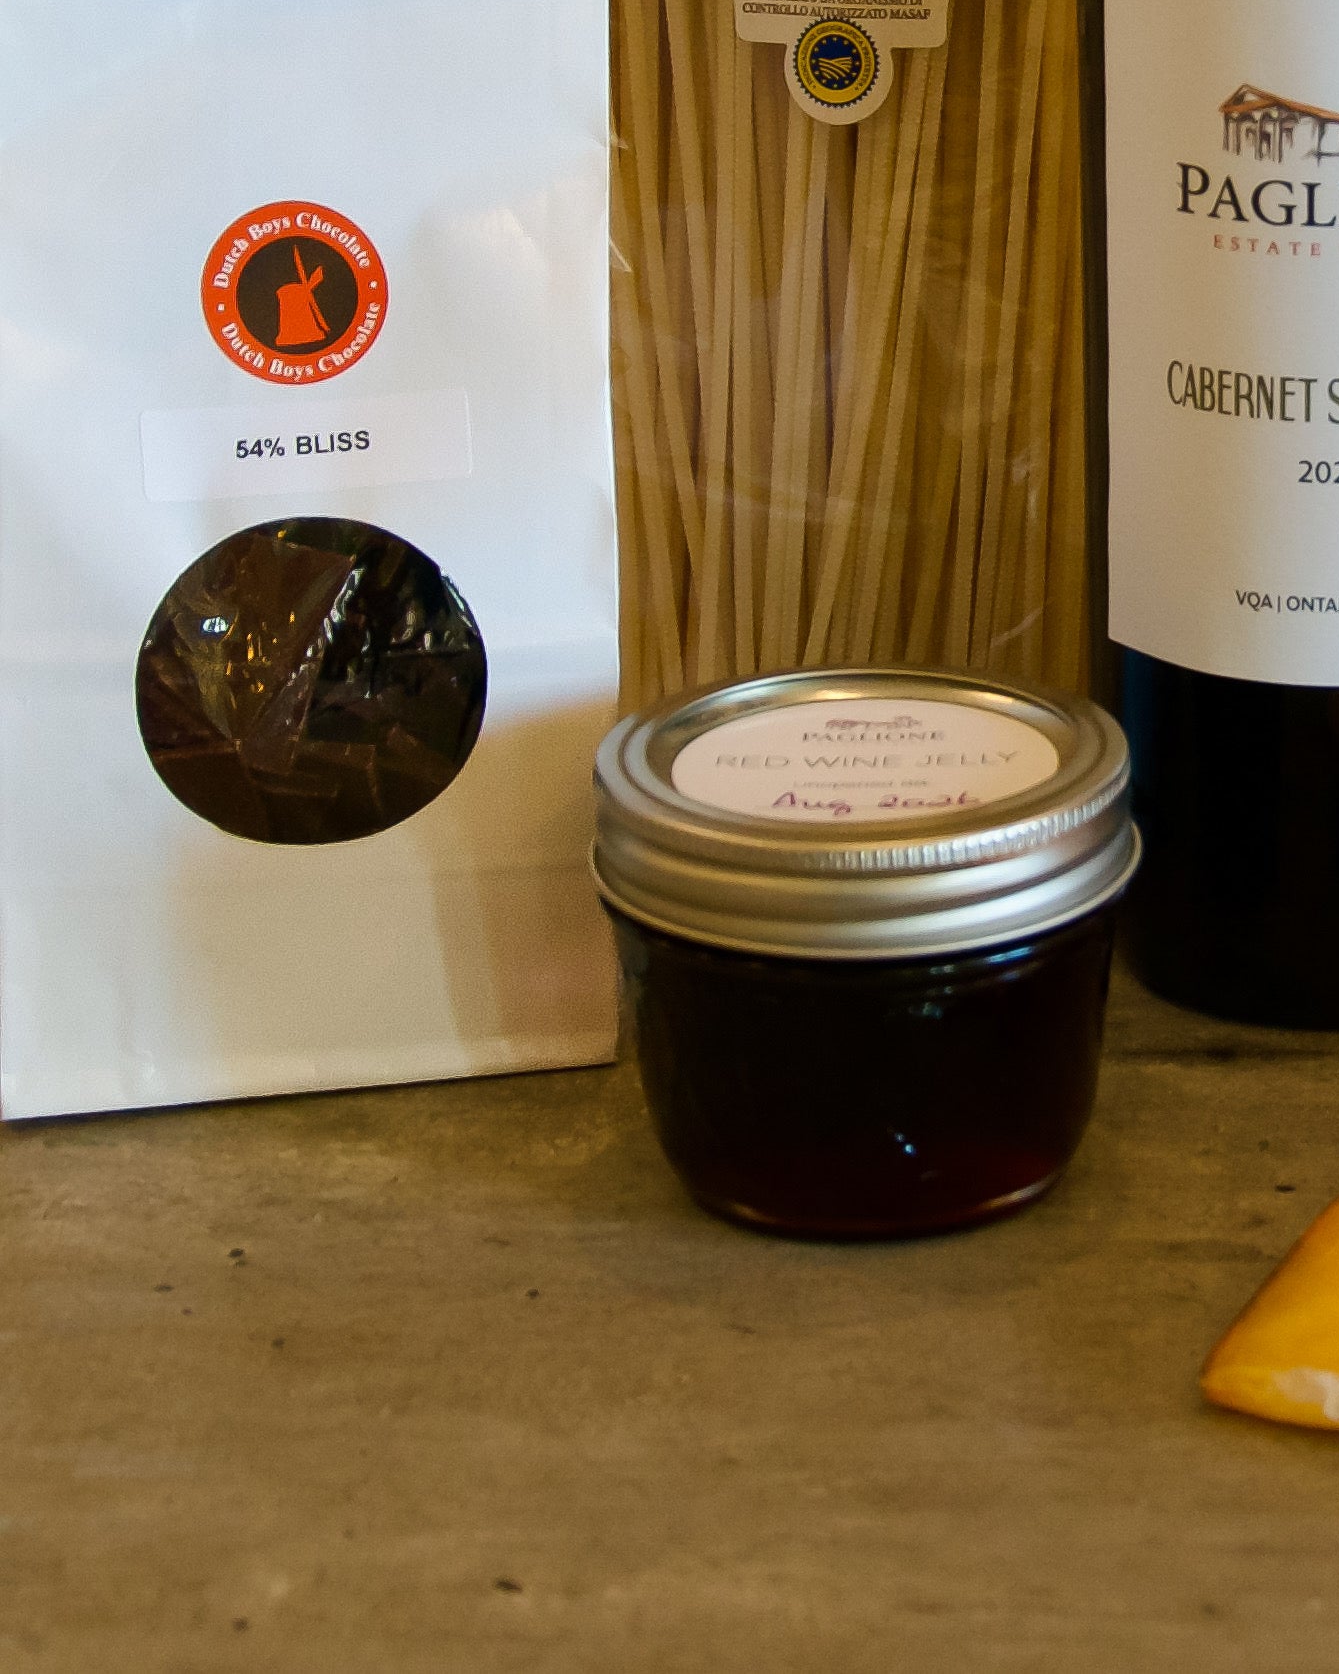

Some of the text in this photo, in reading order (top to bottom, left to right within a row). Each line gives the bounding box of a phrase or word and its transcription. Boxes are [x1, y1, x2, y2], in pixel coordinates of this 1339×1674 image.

[742, 2, 809, 17] CONTROLLO
[810, 6, 888, 20] AUTORIZZATO
[213, 211, 372, 289] Dutch Boys Chocolate
[1212, 233, 1322, 257] ESTATE
[220, 300, 382, 383] Dutch Boys Chocolate
[1166, 359, 1318, 423] CABERNET
[235, 429, 371, 459] 54% BLISS
[1235, 589, 1273, 612] VQA
[715, 750, 1019, 768] RED WINE JELLY
